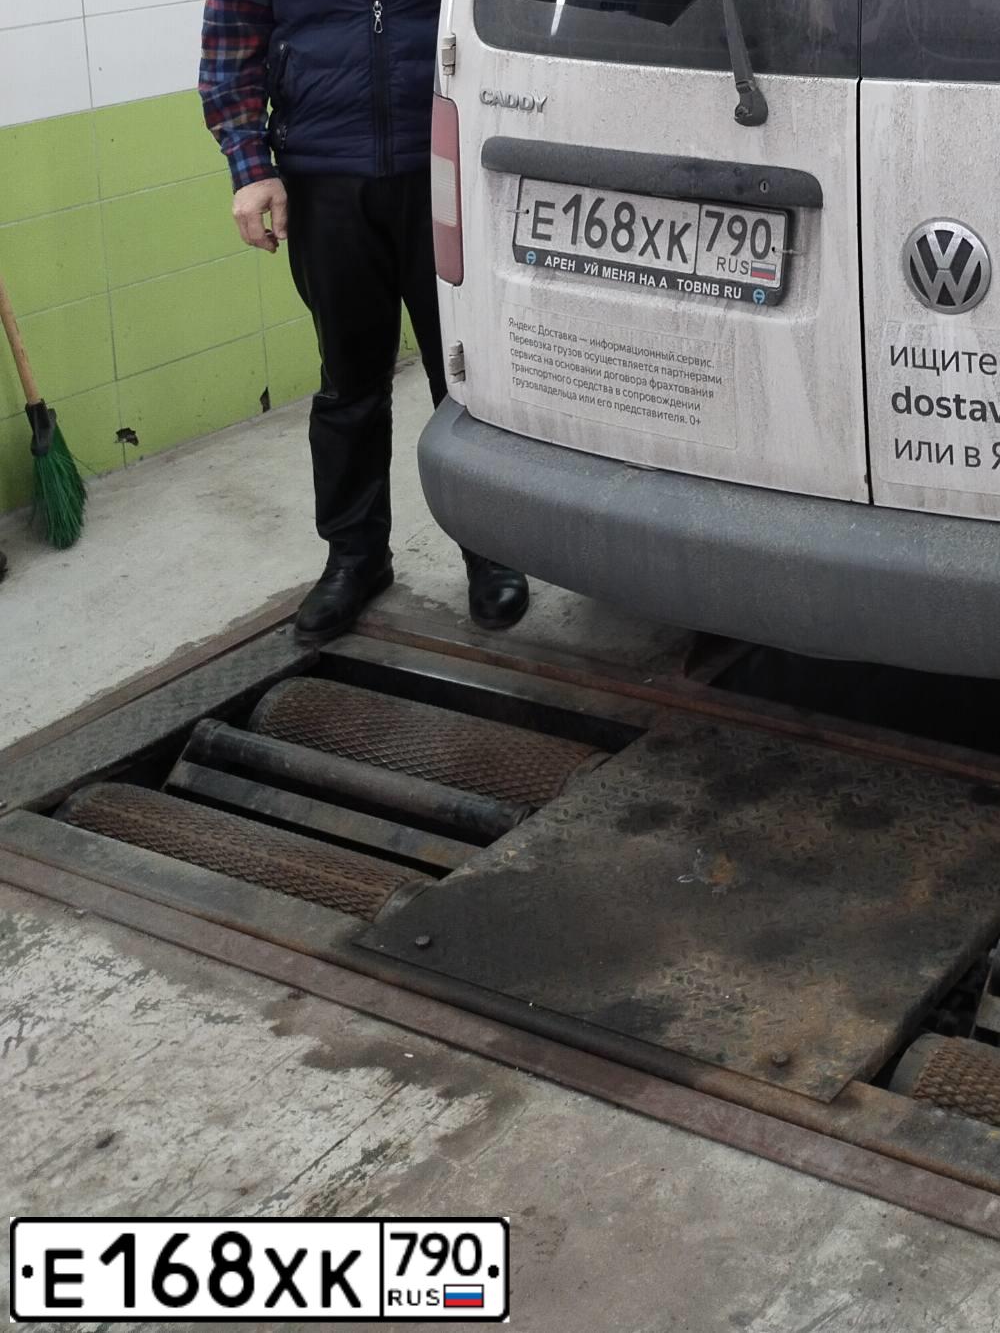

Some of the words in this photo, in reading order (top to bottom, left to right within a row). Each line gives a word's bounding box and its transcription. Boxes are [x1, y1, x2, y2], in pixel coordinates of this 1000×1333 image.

[479, 89, 548, 113] CADDY
[531, 194, 693, 264] Е168ХК
[704, 209, 772, 260] 790
[544, 255, 576, 272] АРЕН
[602, 267, 635, 284] МЕНЯ
[639, 274, 656, 287] НА
[724, 285, 742, 299] RU
[717, 257, 750, 275] RUS
[508, 317, 537, 333] Яндекс
[538, 324, 578, 343] Доставка
[589, 338, 675, 362] информационный
[676, 353, 715, 369] сервис.
[509, 332, 552, 352] Перевозка
[553, 345, 583, 358] грузов
[584, 352, 659, 373] осуществляется
[661, 366, 722, 385] партнерами
[889, 344, 998, 377] ищите
[510, 348, 542, 363] сервиса
[543, 357, 554, 366] на
[555, 359, 602, 377] основании
[603, 370, 647, 387] договора
[649, 377, 714, 398] фрахтования
[511, 362, 572, 385] транспортного
[573, 378, 614, 394] средства
[622, 388, 701, 411] сопровождении
[512, 376, 577, 401] грузовладельца
[578, 394, 595, 405] или
[597, 398, 613, 408] его
[614, 401, 688, 424] представителя.
[689, 415, 702, 426] 0+
[894, 437, 955, 467] или
[964, 445, 982, 469] в
